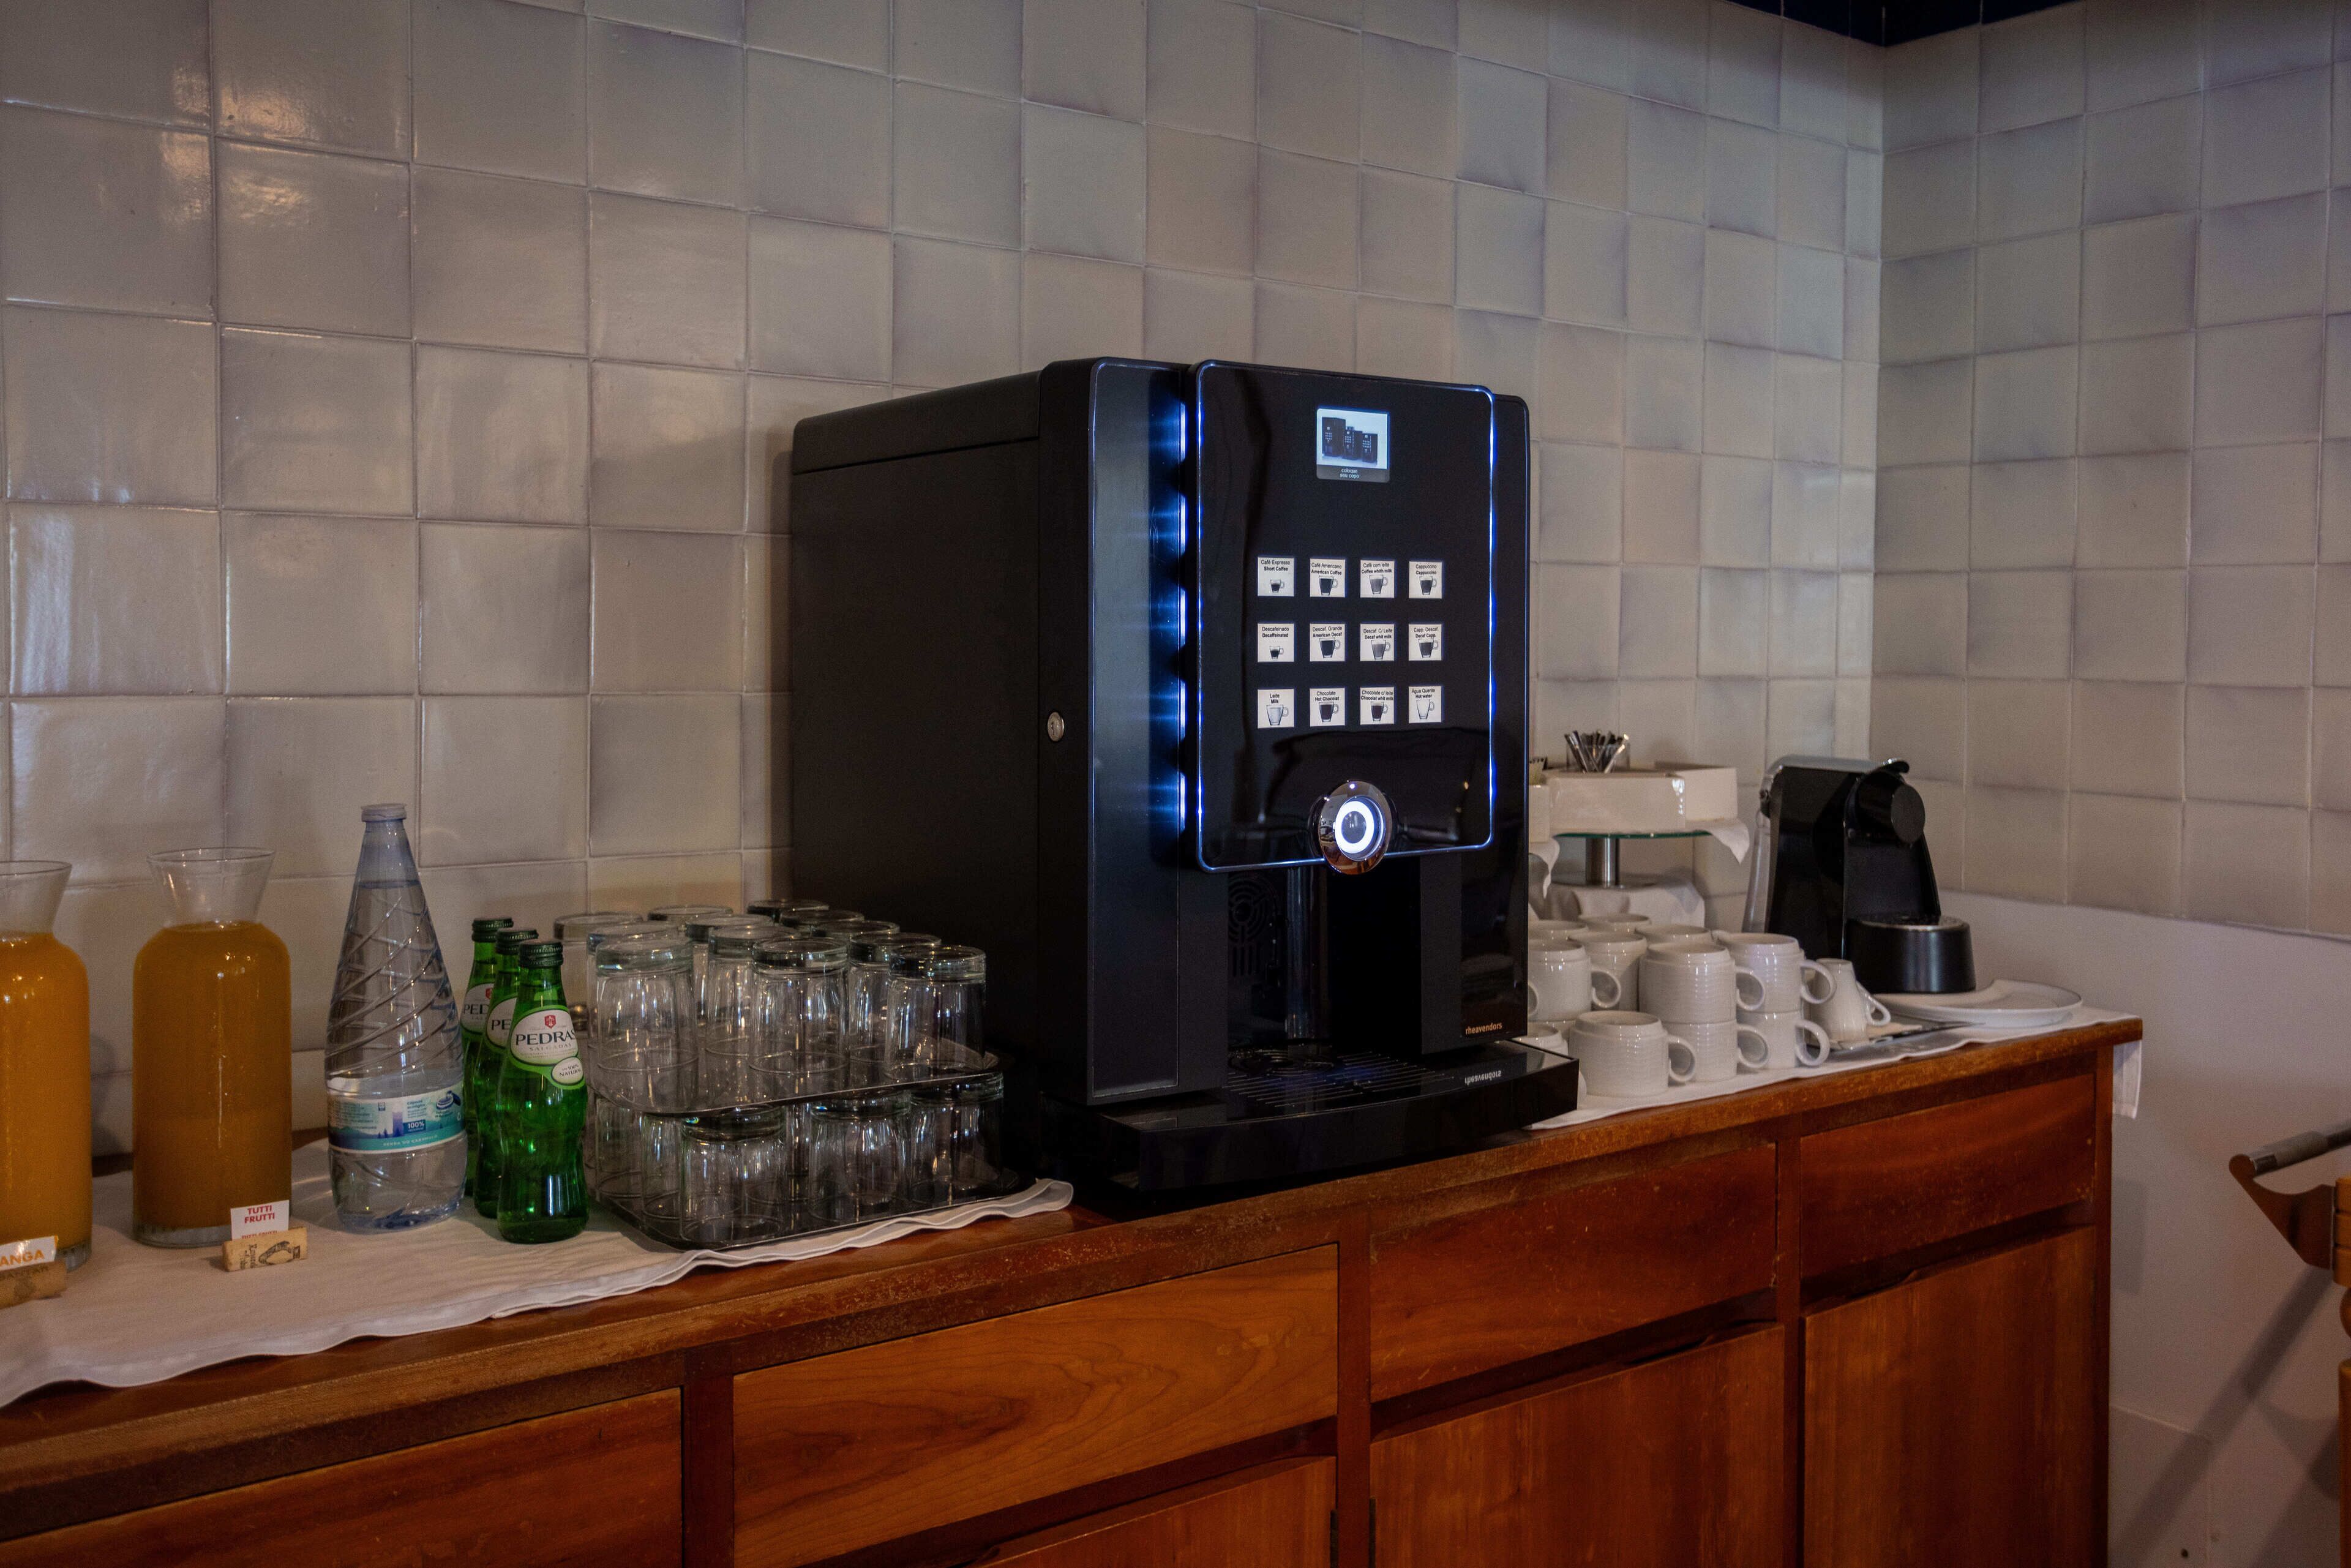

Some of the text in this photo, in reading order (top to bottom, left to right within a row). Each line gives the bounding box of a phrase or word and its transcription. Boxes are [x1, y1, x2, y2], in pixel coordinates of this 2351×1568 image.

[1465, 1022, 1502, 1035] rheavendors
[516, 1028, 576, 1046] PEDRAS
[247, 1205, 272, 1215] TUTTI
[244, 1213, 276, 1223] FRUTTI
